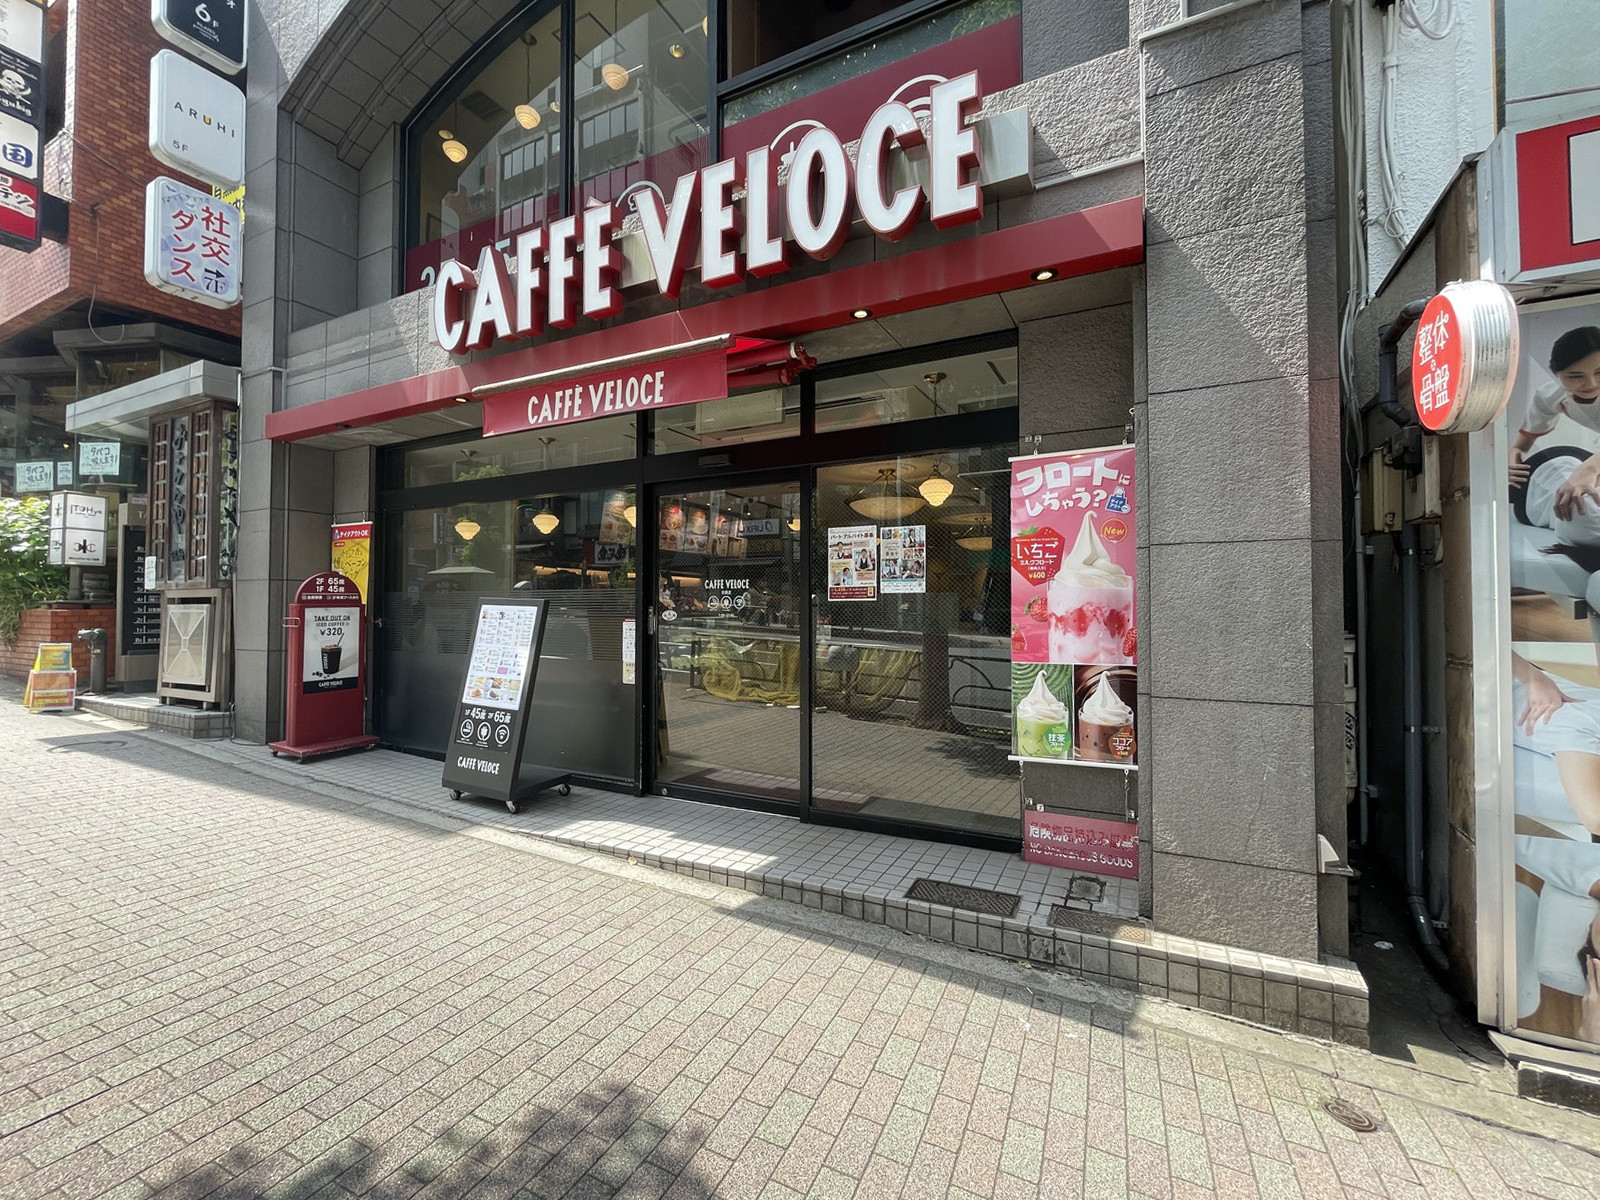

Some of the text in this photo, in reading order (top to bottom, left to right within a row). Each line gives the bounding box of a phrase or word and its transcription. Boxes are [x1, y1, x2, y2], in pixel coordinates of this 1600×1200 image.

[174, 101, 235, 138] ARUHI
[173, 140, 189, 152] 5F
[634, 69, 984, 299] VELOCE
[201, 206, 231, 266] 社交
[171, 210, 199, 282] ダンス
[588, 371, 665, 413] VELOCE
[1420, 364, 1450, 414] 骨盤
[1016, 457, 1131, 496] フロートに
[1105, 526, 1125, 536] New
[1017, 541, 1059, 559] いちご
[725, 578, 750, 589] VELOCE
[320, 627, 343, 636] ¥320
[1048, 733, 1065, 742] 抹茶
[1112, 737, 1133, 746] ココア
[477, 759, 500, 775] VELOCE
